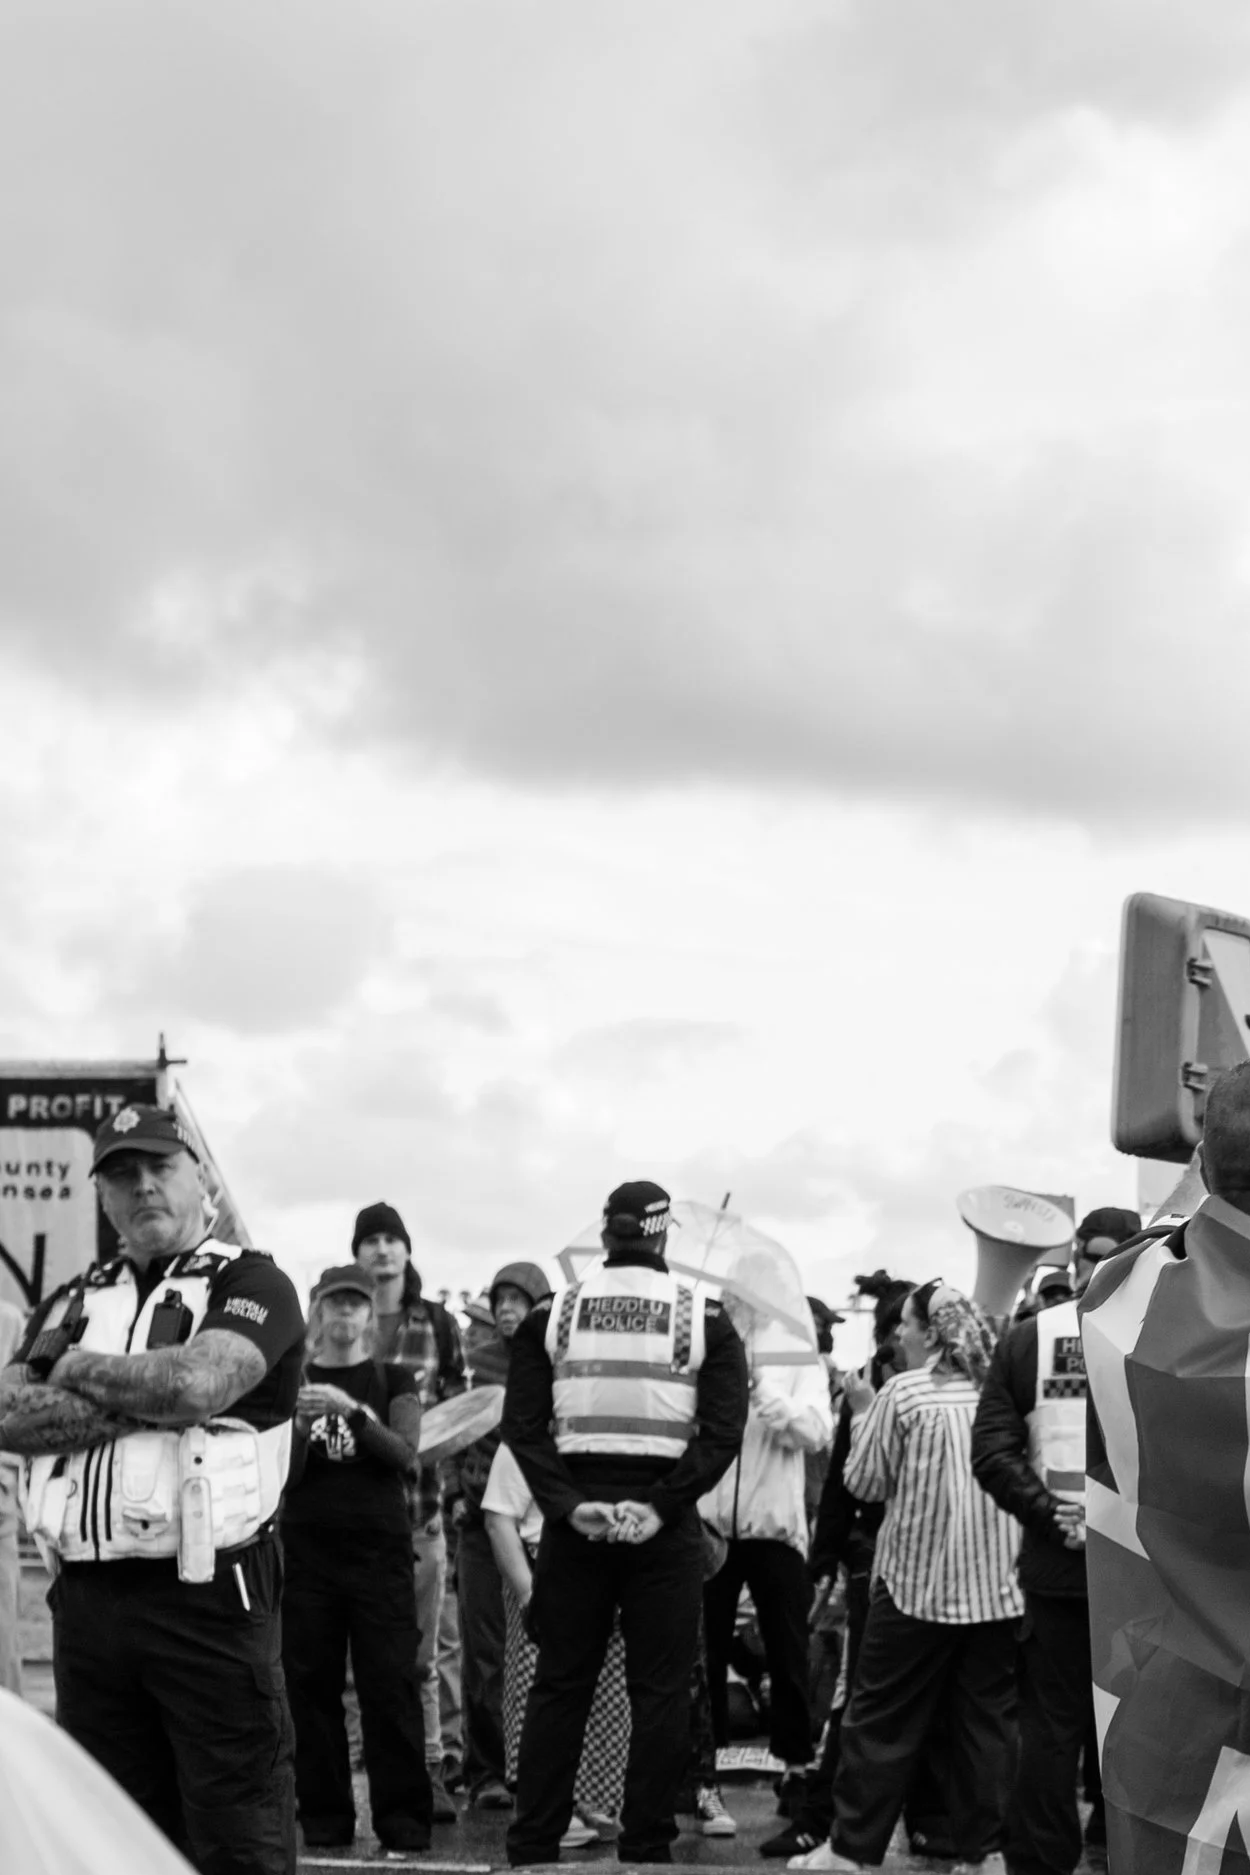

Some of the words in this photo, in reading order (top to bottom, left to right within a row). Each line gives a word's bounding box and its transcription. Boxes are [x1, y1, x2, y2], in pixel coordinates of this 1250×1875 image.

[7, 1094, 126, 1119] PROFIT
[1, 1159, 71, 1179] unty
[2, 1184, 71, 1200] nsea
[587, 1296, 664, 1315] HEDDLU
[589, 1313, 657, 1331] POLICE
